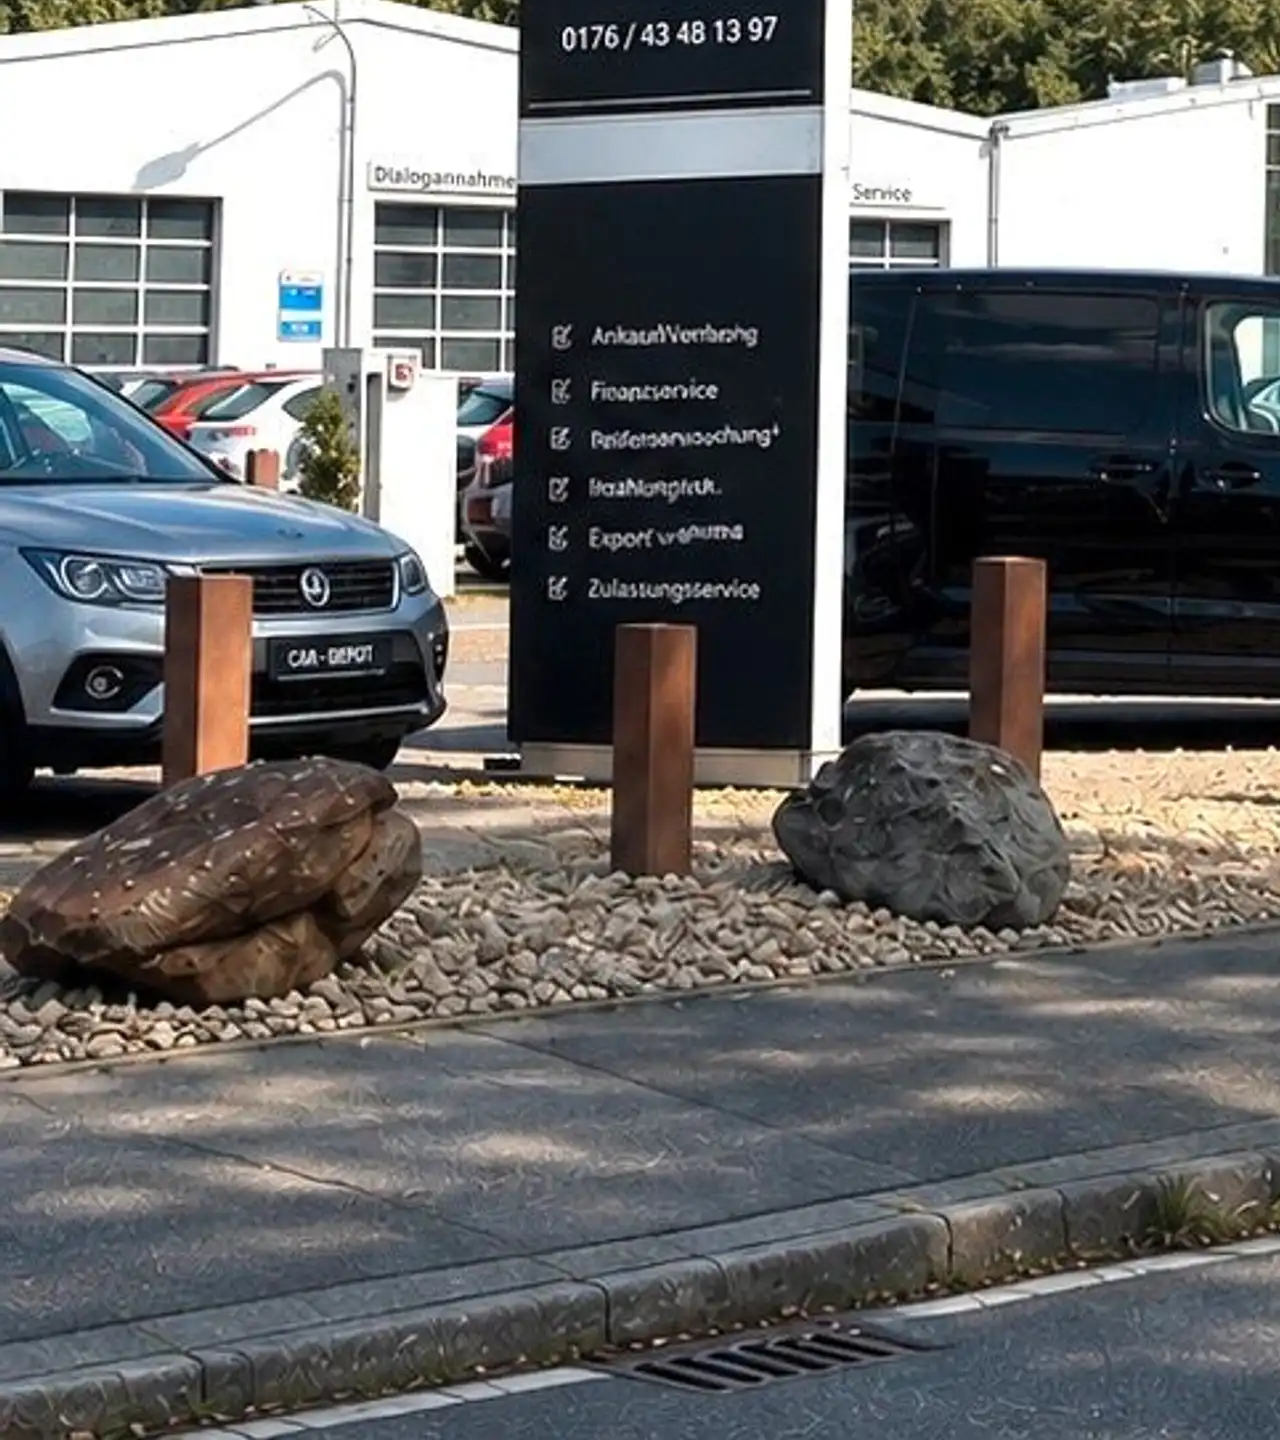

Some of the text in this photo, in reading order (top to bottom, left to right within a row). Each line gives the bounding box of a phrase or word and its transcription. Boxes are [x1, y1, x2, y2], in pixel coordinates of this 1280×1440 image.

[561, 15, 779, 52] 0176 / 43 48 13 97
[851, 182, 912, 202] Service
